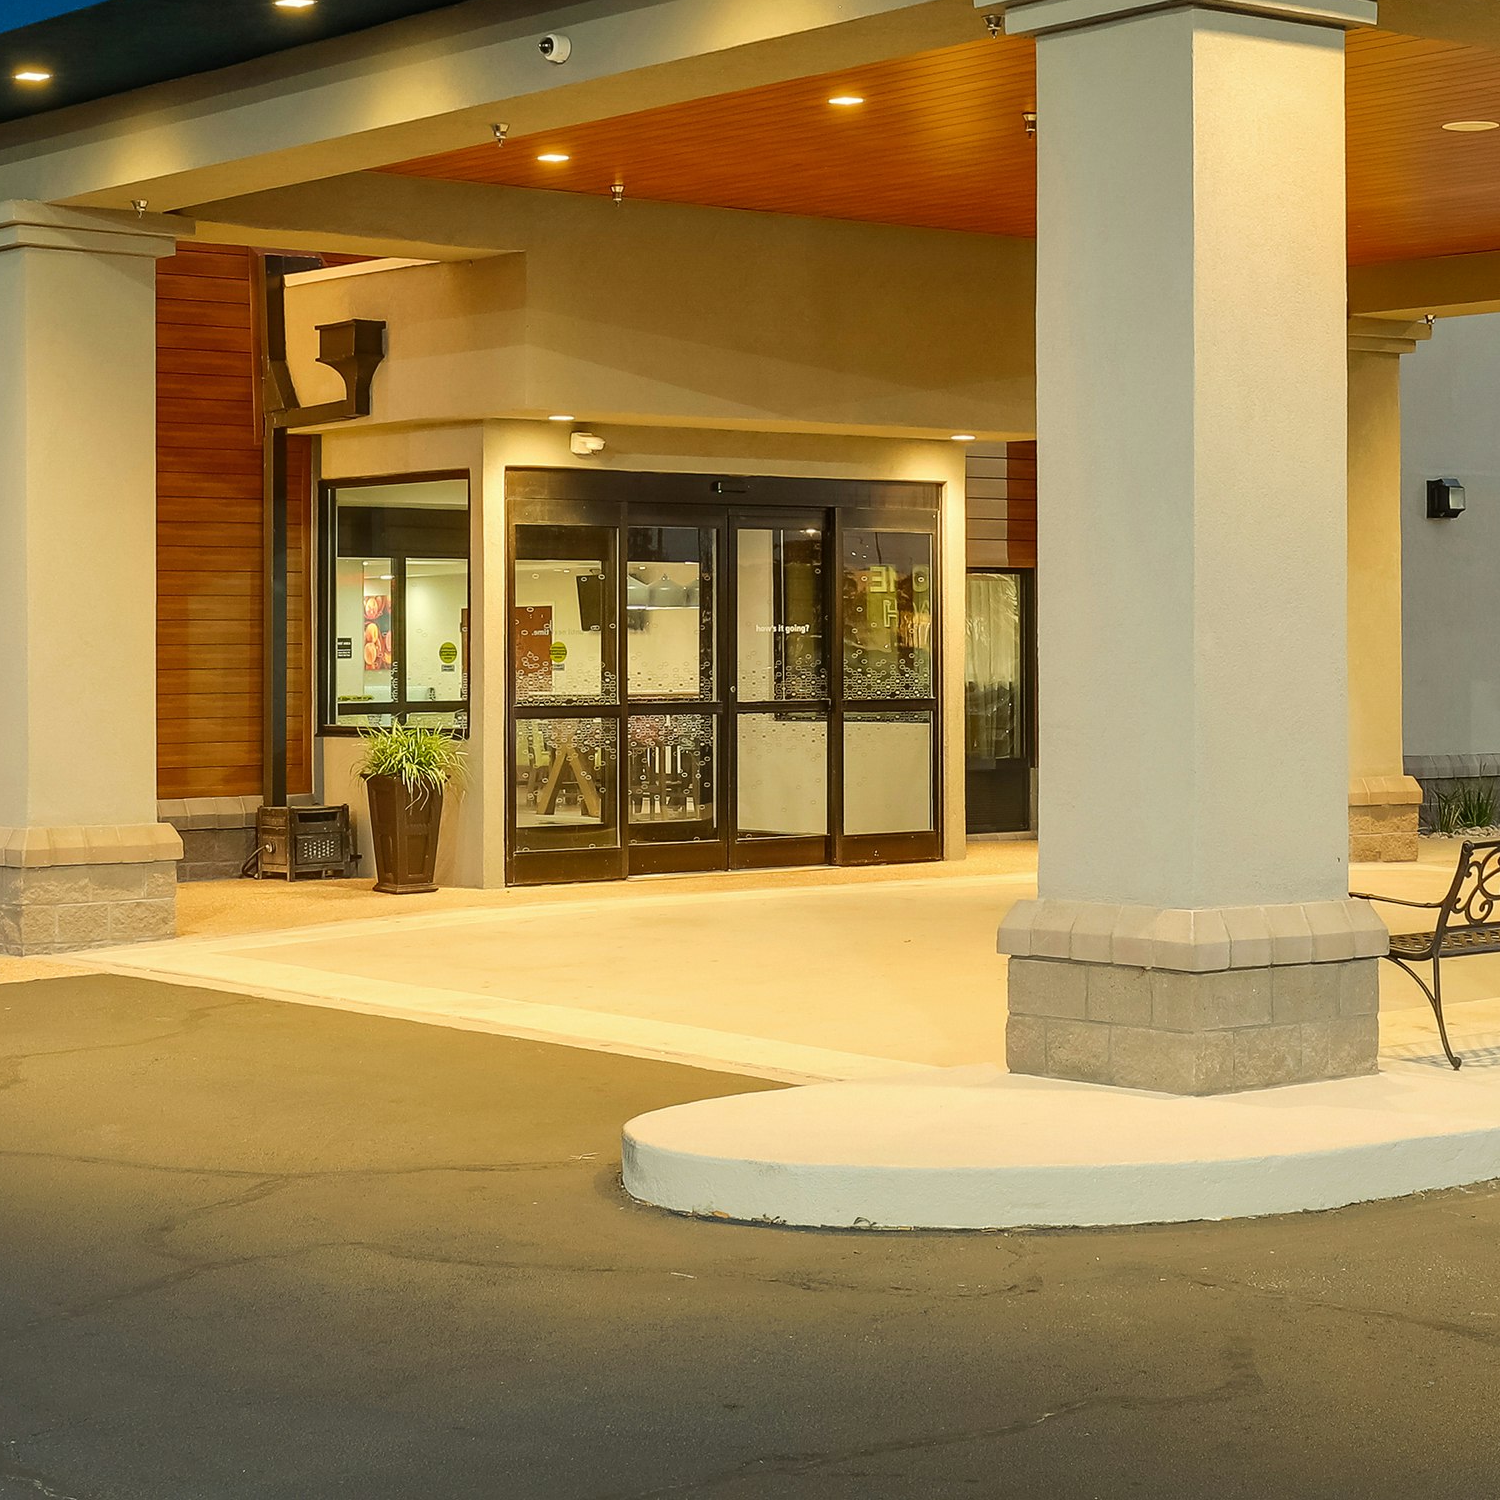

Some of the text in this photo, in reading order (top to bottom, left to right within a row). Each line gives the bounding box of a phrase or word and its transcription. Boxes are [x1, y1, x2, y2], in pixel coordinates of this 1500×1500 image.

[755, 624, 810, 634] how's it going?
